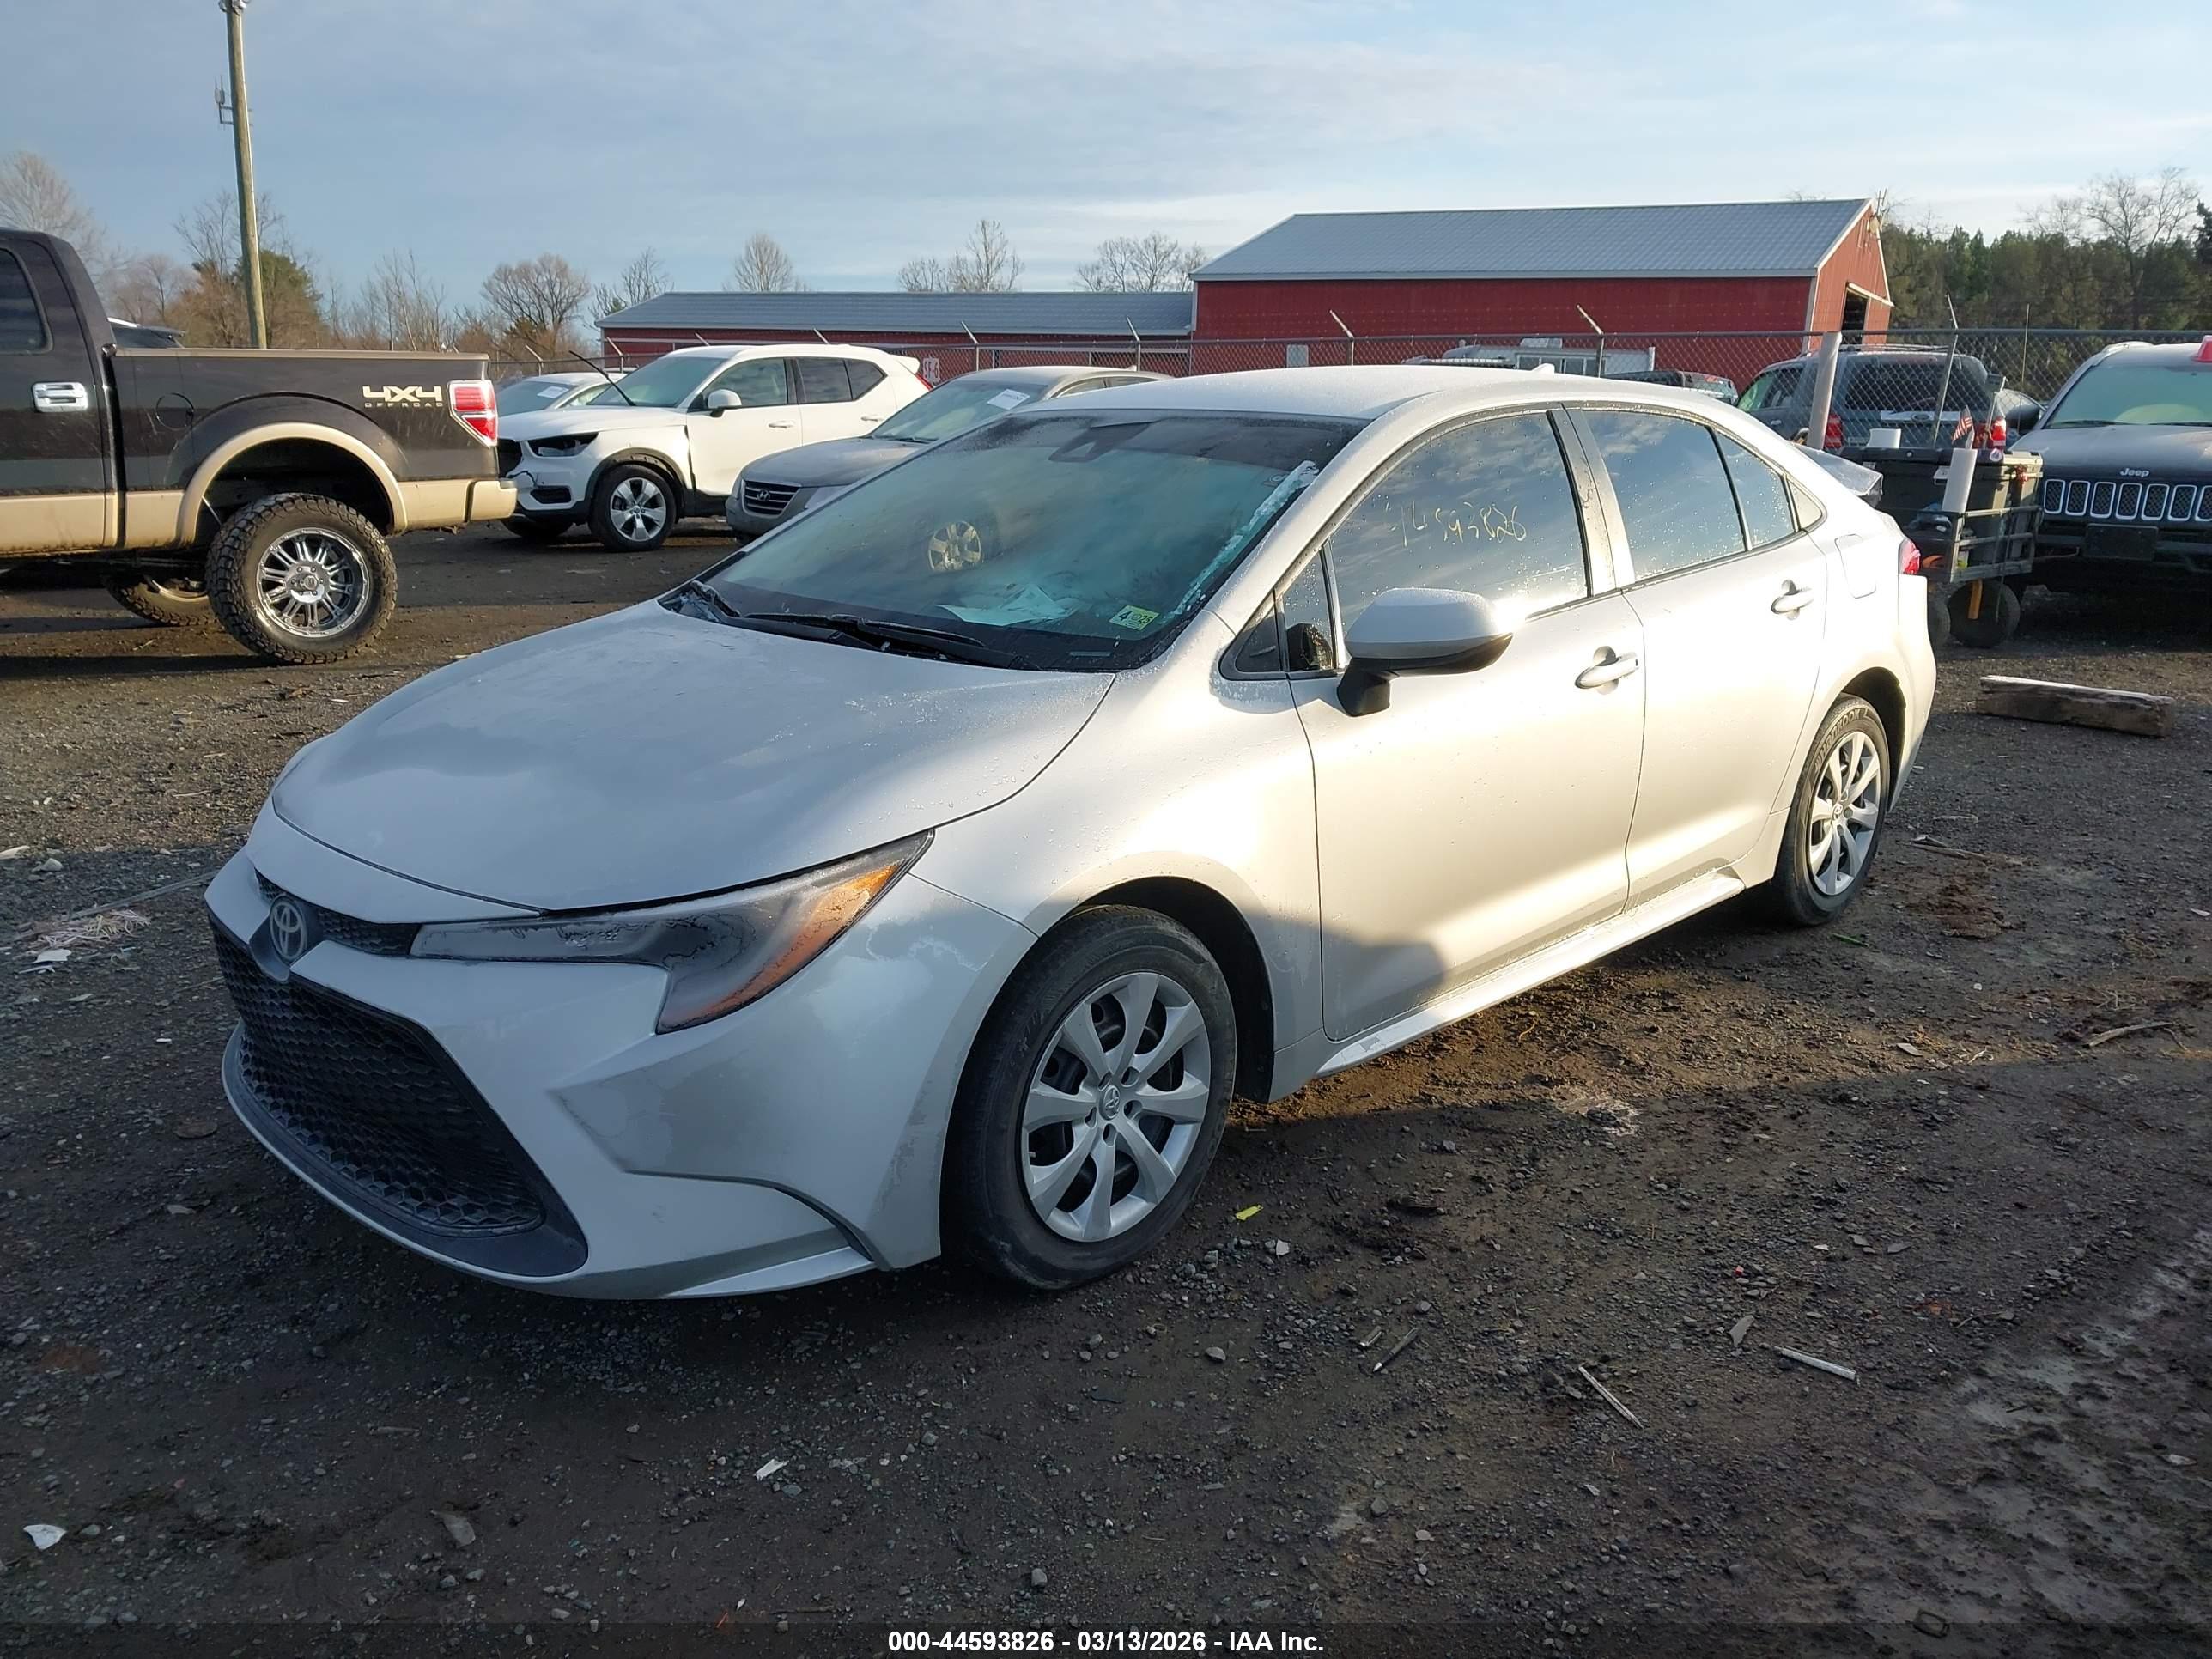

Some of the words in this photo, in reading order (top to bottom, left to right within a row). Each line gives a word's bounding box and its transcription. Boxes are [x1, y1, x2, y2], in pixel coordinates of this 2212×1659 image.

[362, 386, 443, 402] 4X4
[2120, 467, 2150, 478] Jeep
[1118, 611, 1133, 622] 4
